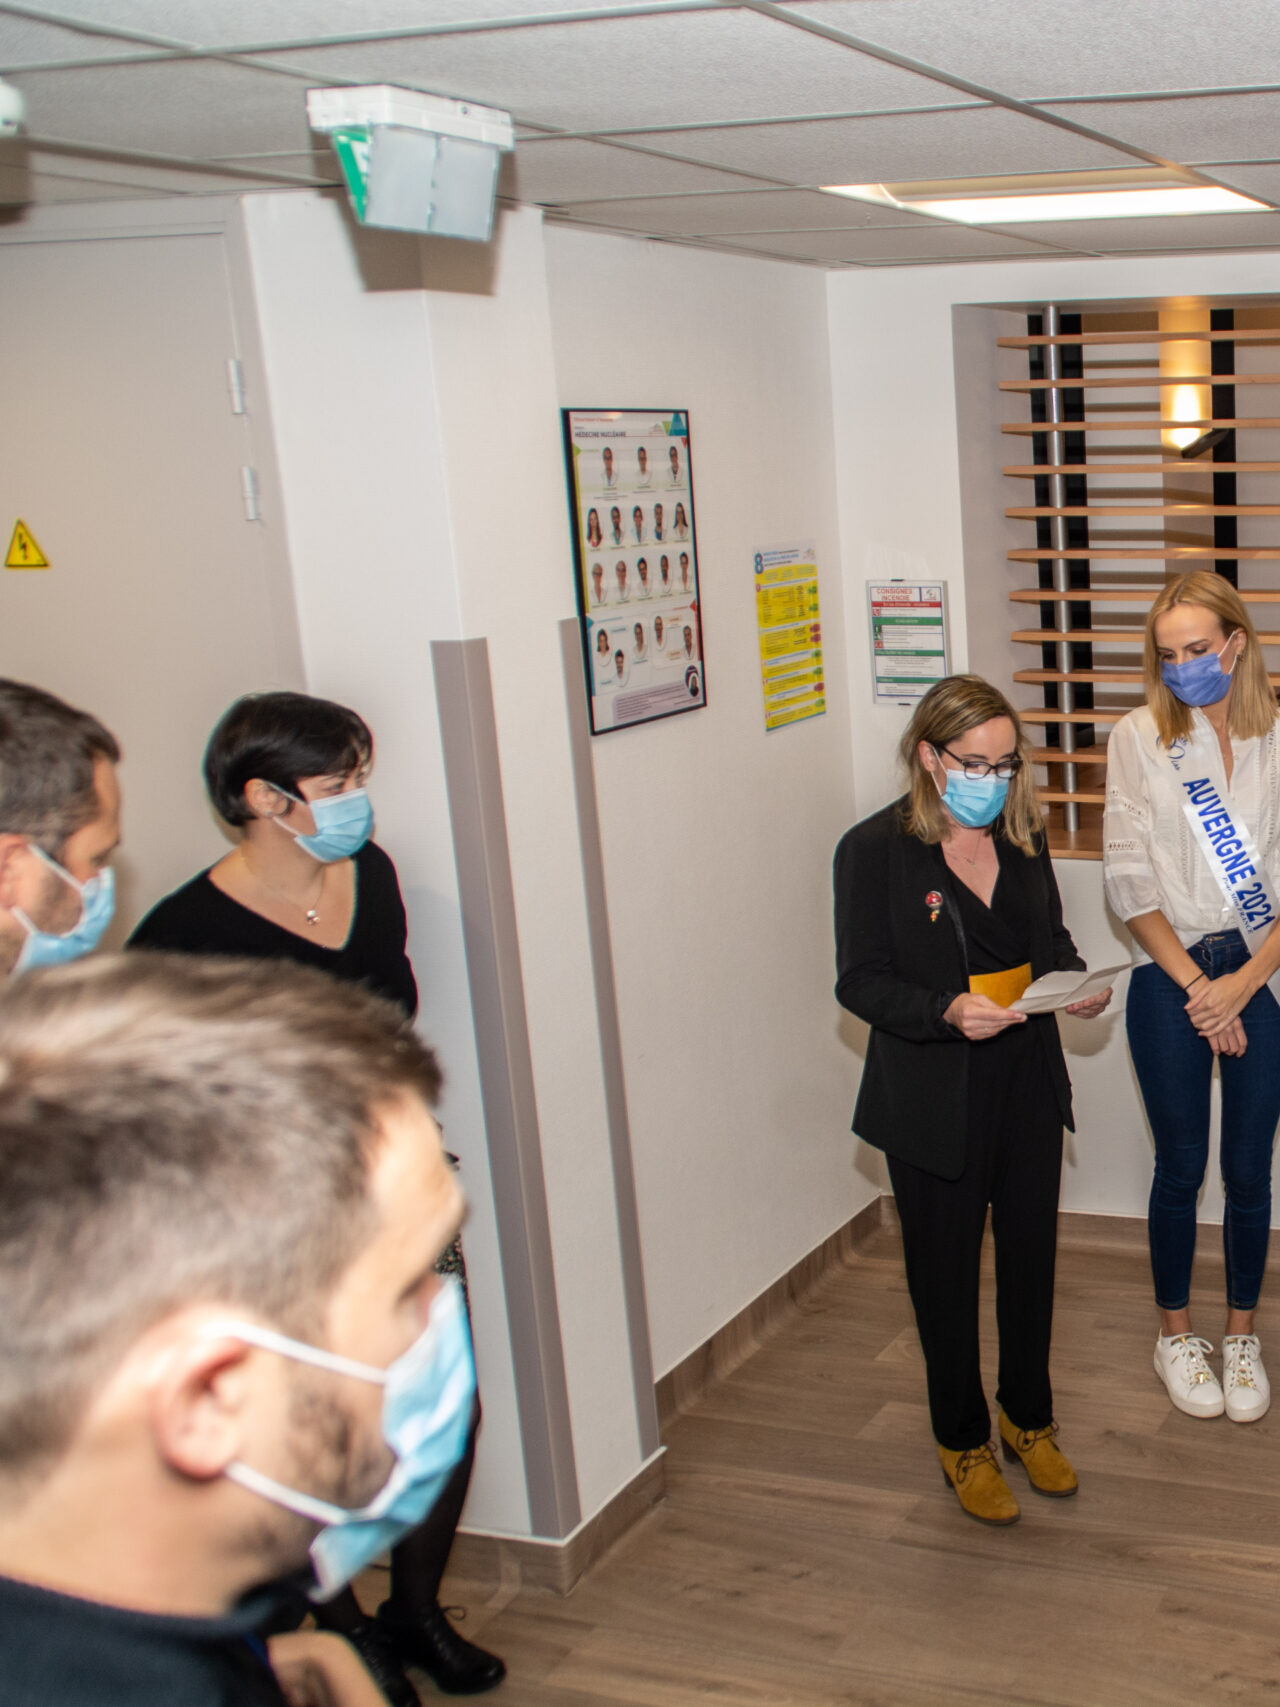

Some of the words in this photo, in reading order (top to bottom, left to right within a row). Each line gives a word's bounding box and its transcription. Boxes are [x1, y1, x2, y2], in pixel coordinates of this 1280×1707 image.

[754, 552, 764, 574] 8
[1182, 777, 1256, 885] AUVERGNE
[1236, 881, 1276, 931] 2021
